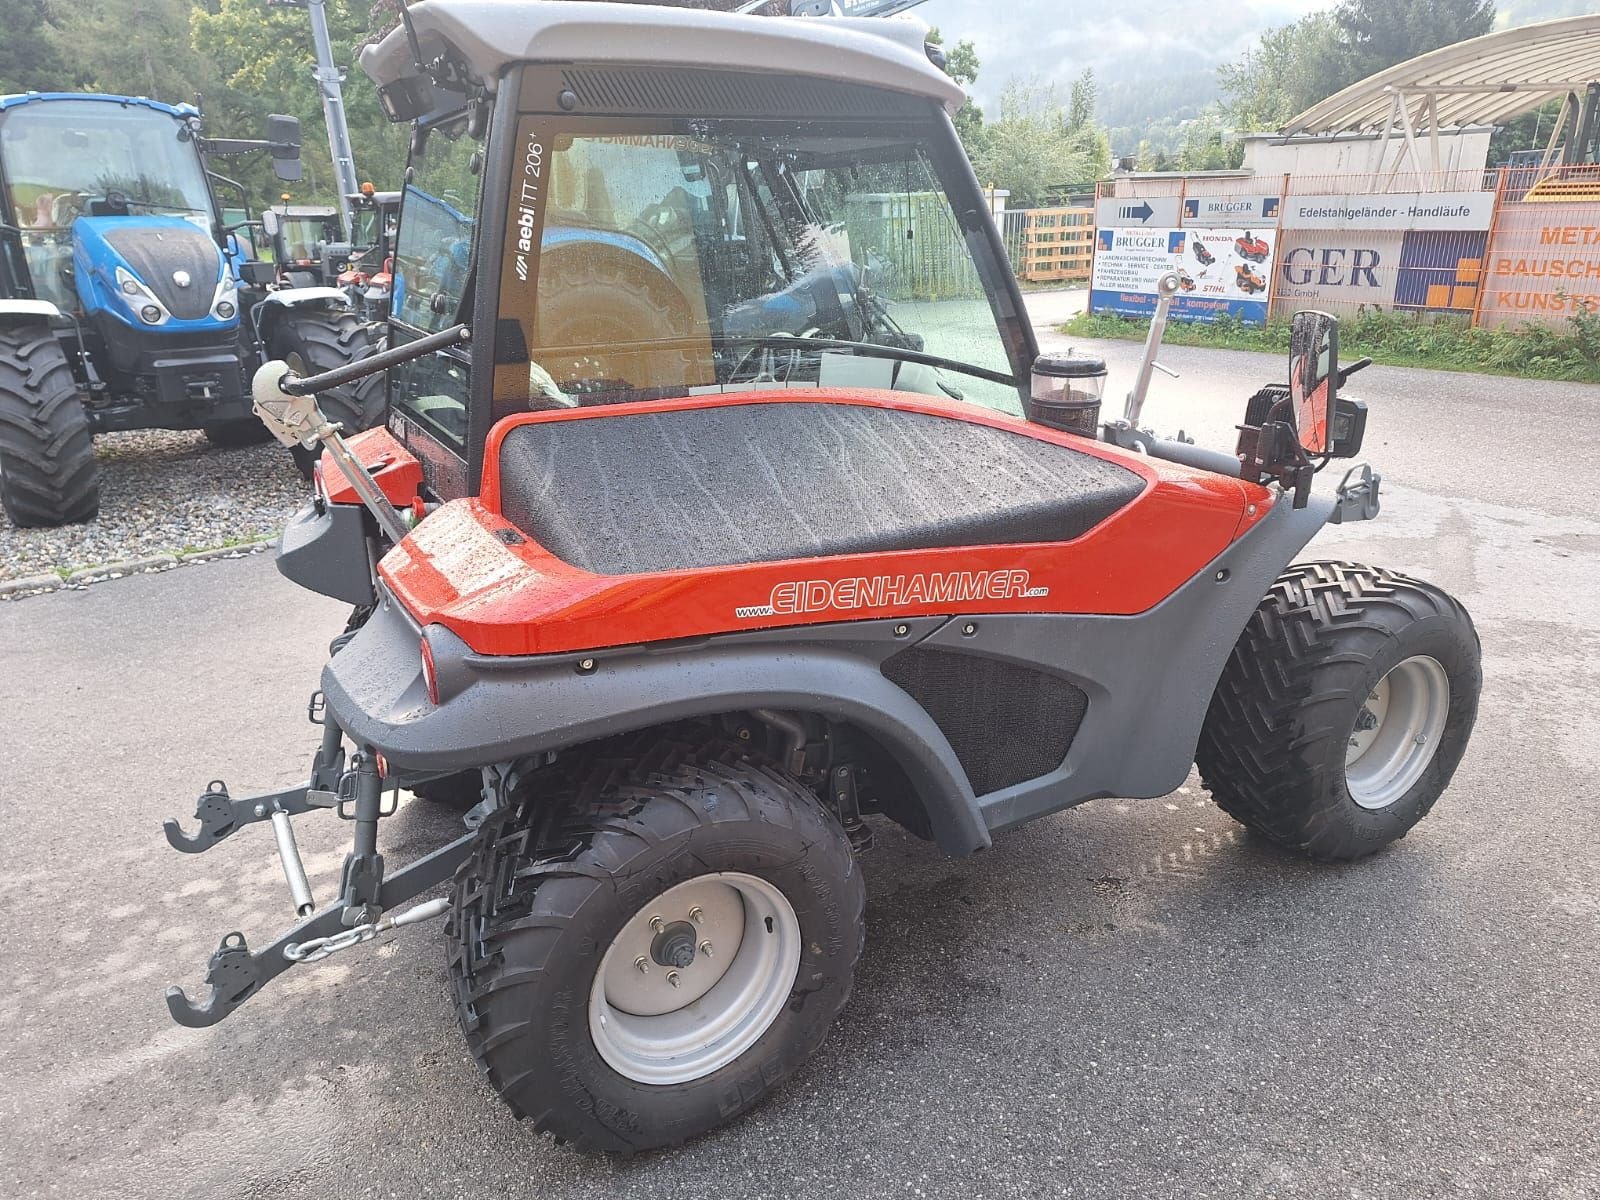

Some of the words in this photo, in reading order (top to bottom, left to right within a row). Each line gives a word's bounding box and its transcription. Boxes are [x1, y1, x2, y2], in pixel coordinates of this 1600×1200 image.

[521, 179, 538, 201] TT
[1207, 202, 1253, 212] BRUGGER
[1299, 206, 1398, 220] Edelstahlgeländer
[1407, 205, 1471, 217] Handläufe
[517, 206, 535, 252] aebi
[1115, 236, 1165, 248] BRUGGER
[1282, 247, 1382, 288] GER
[1202, 284, 1225, 293] STIHL
[1294, 288, 1319, 297] GmbH
[1120, 293, 1147, 304] flexibel
[1187, 299, 1230, 311] kompetent
